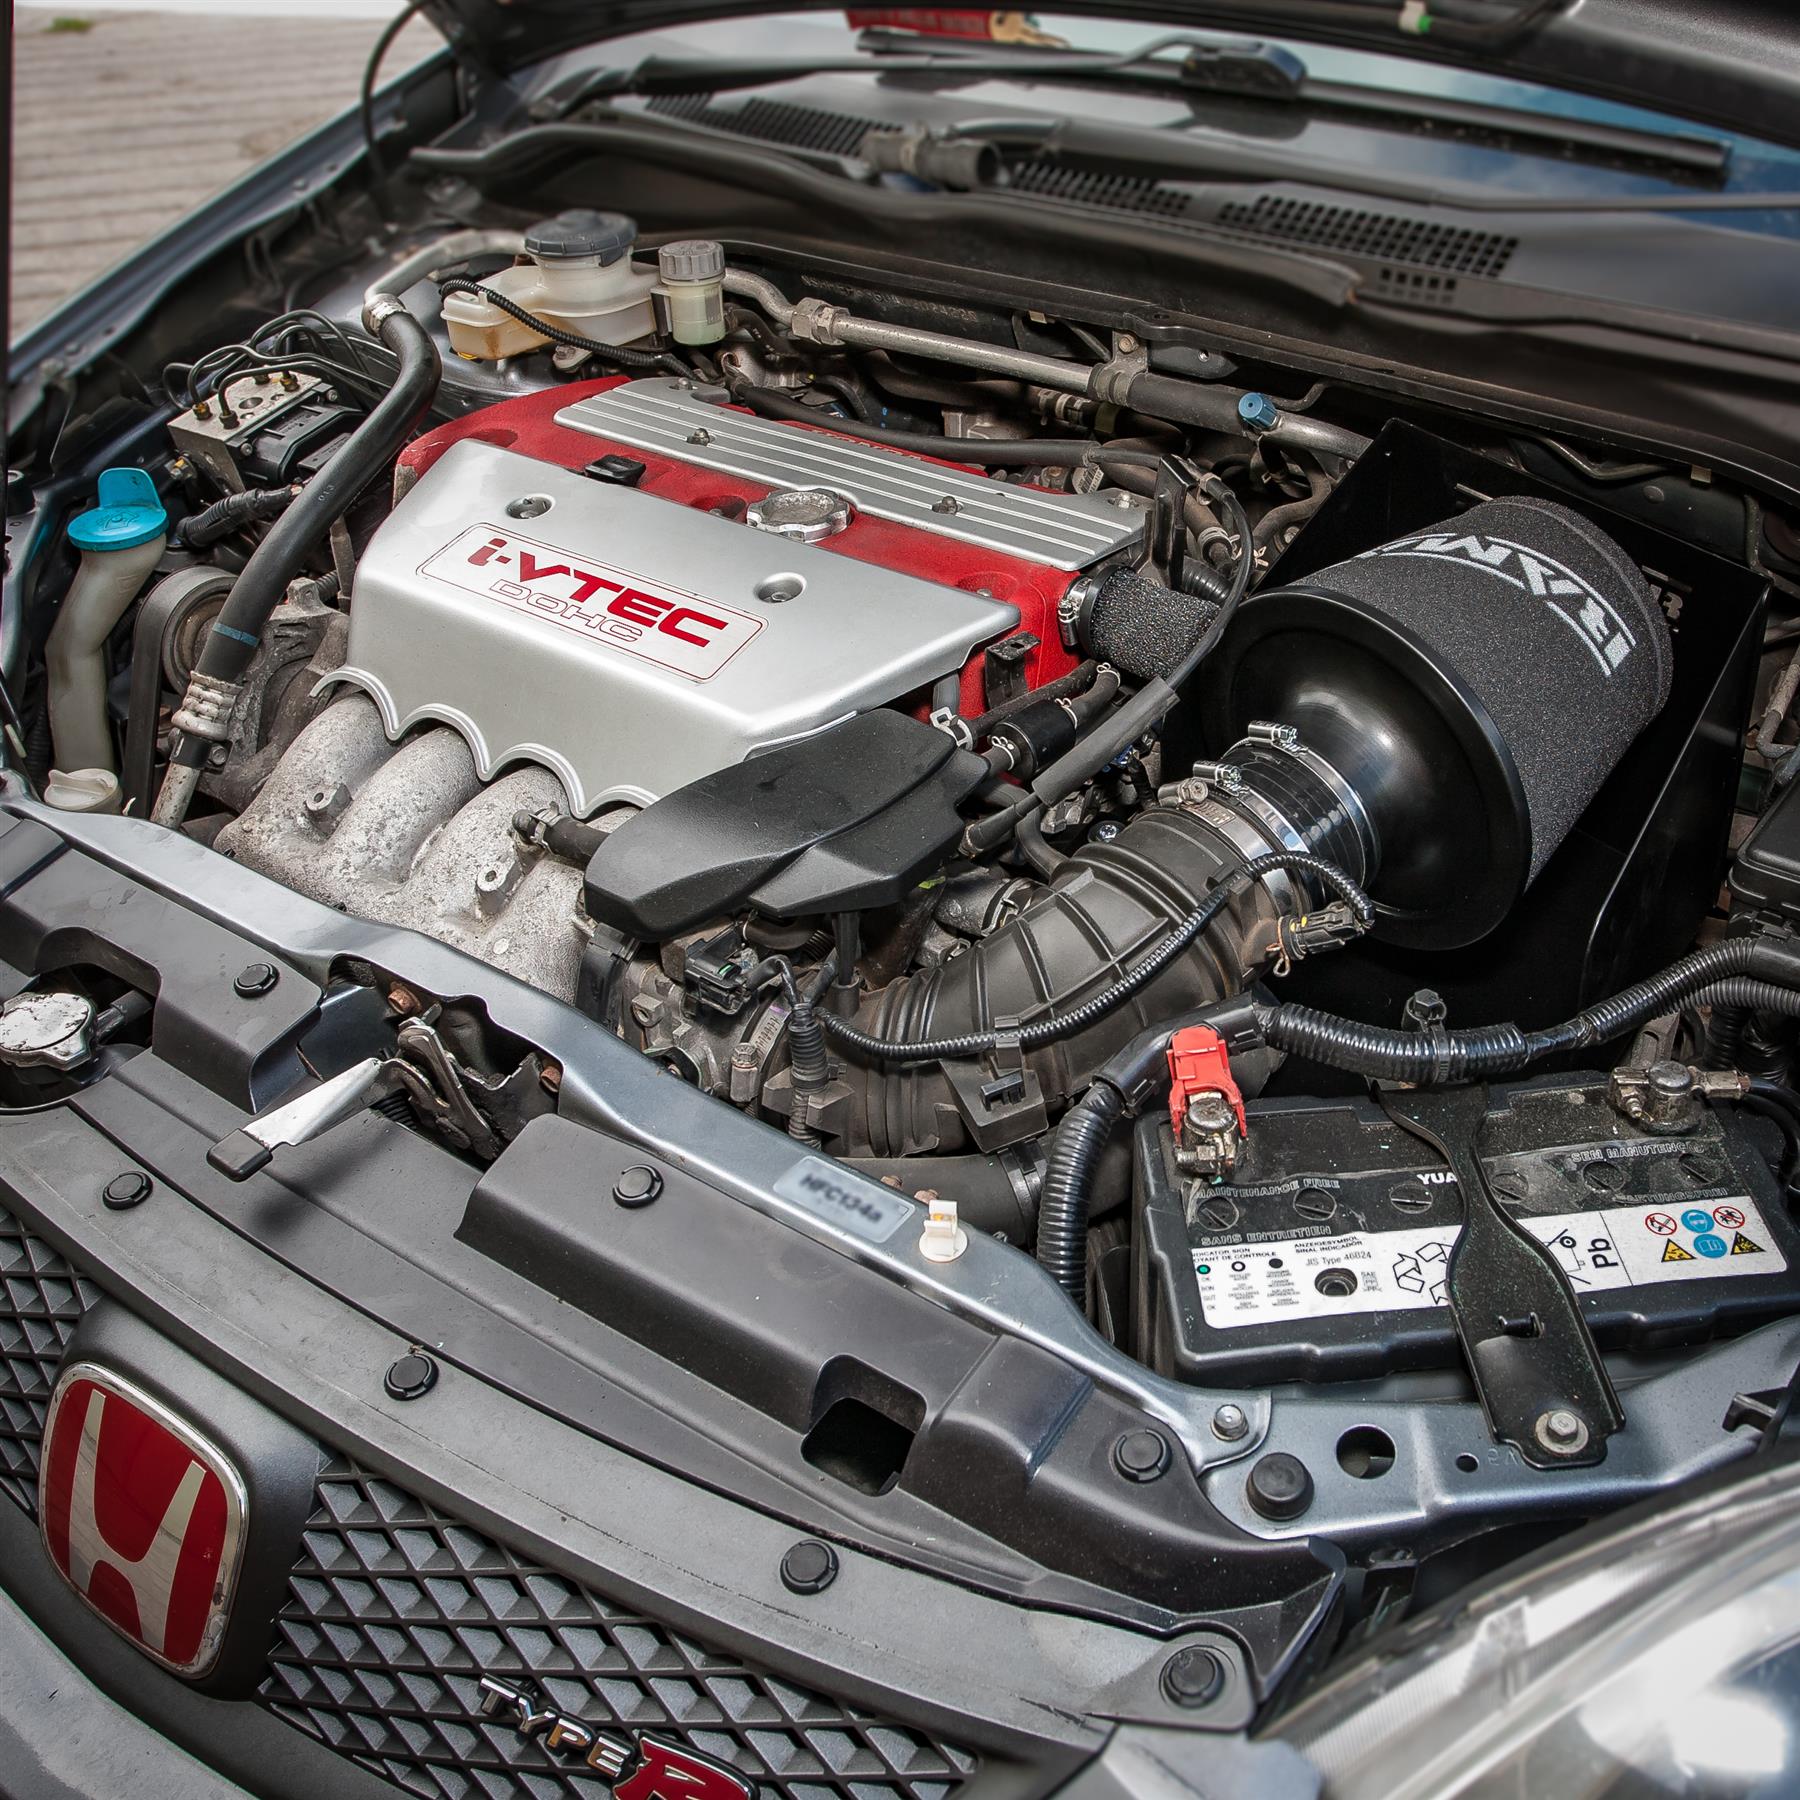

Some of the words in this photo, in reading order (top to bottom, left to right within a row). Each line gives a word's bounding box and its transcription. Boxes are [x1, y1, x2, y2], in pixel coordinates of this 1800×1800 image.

[467, 537, 729, 648] i-VTEC
[489, 578, 643, 642] DOHC
[1571, 1150, 1604, 1162] SEM
[1303, 1177, 1341, 1190] FREE
[1201, 1233, 1243, 1246] SANS
[1246, 1225, 1332, 1243] ENTRETIEN
[1588, 1238, 1618, 1269] Pb
[478, 1674, 636, 1778] TYPE
